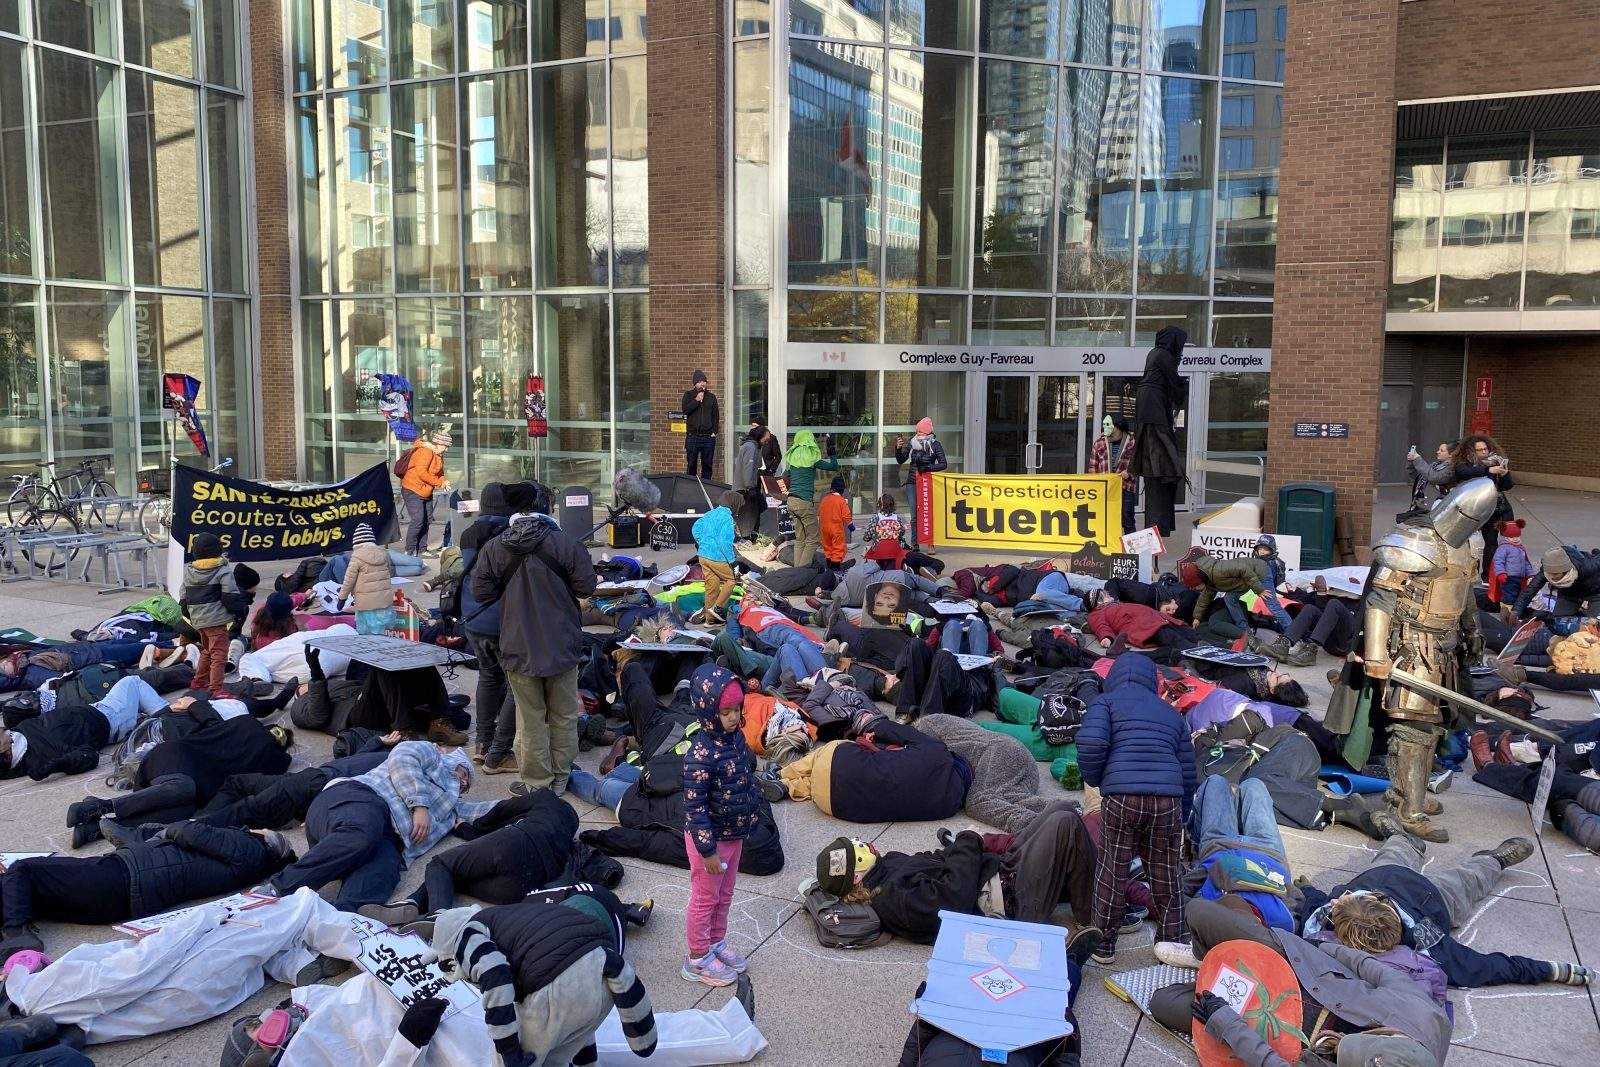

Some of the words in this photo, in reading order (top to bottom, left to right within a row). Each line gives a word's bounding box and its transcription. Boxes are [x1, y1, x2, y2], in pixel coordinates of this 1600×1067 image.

[899, 351, 957, 366] Complexe
[960, 352, 1034, 367] Guy-Favreau
[1081, 353, 1106, 365] 200
[1179, 354, 1216, 366] avreau
[1220, 354, 1264, 367] Complex
[954, 480, 982, 497] les
[990, 484, 1098, 501] pesticides
[190, 503, 287, 527] écoutez
[290, 509, 309, 525] la
[311, 499, 381, 524] science,
[951, 498, 1097, 538] tuent
[187, 532, 232, 553] ps
[240, 531, 274, 549] les
[281, 525, 346, 548] lobbys.
[1073, 555, 1105, 568] octobre
[1113, 558, 1137, 568] LEURS
[1208, 549, 1255, 561] ESTICI
[368, 943, 397, 965] LES
